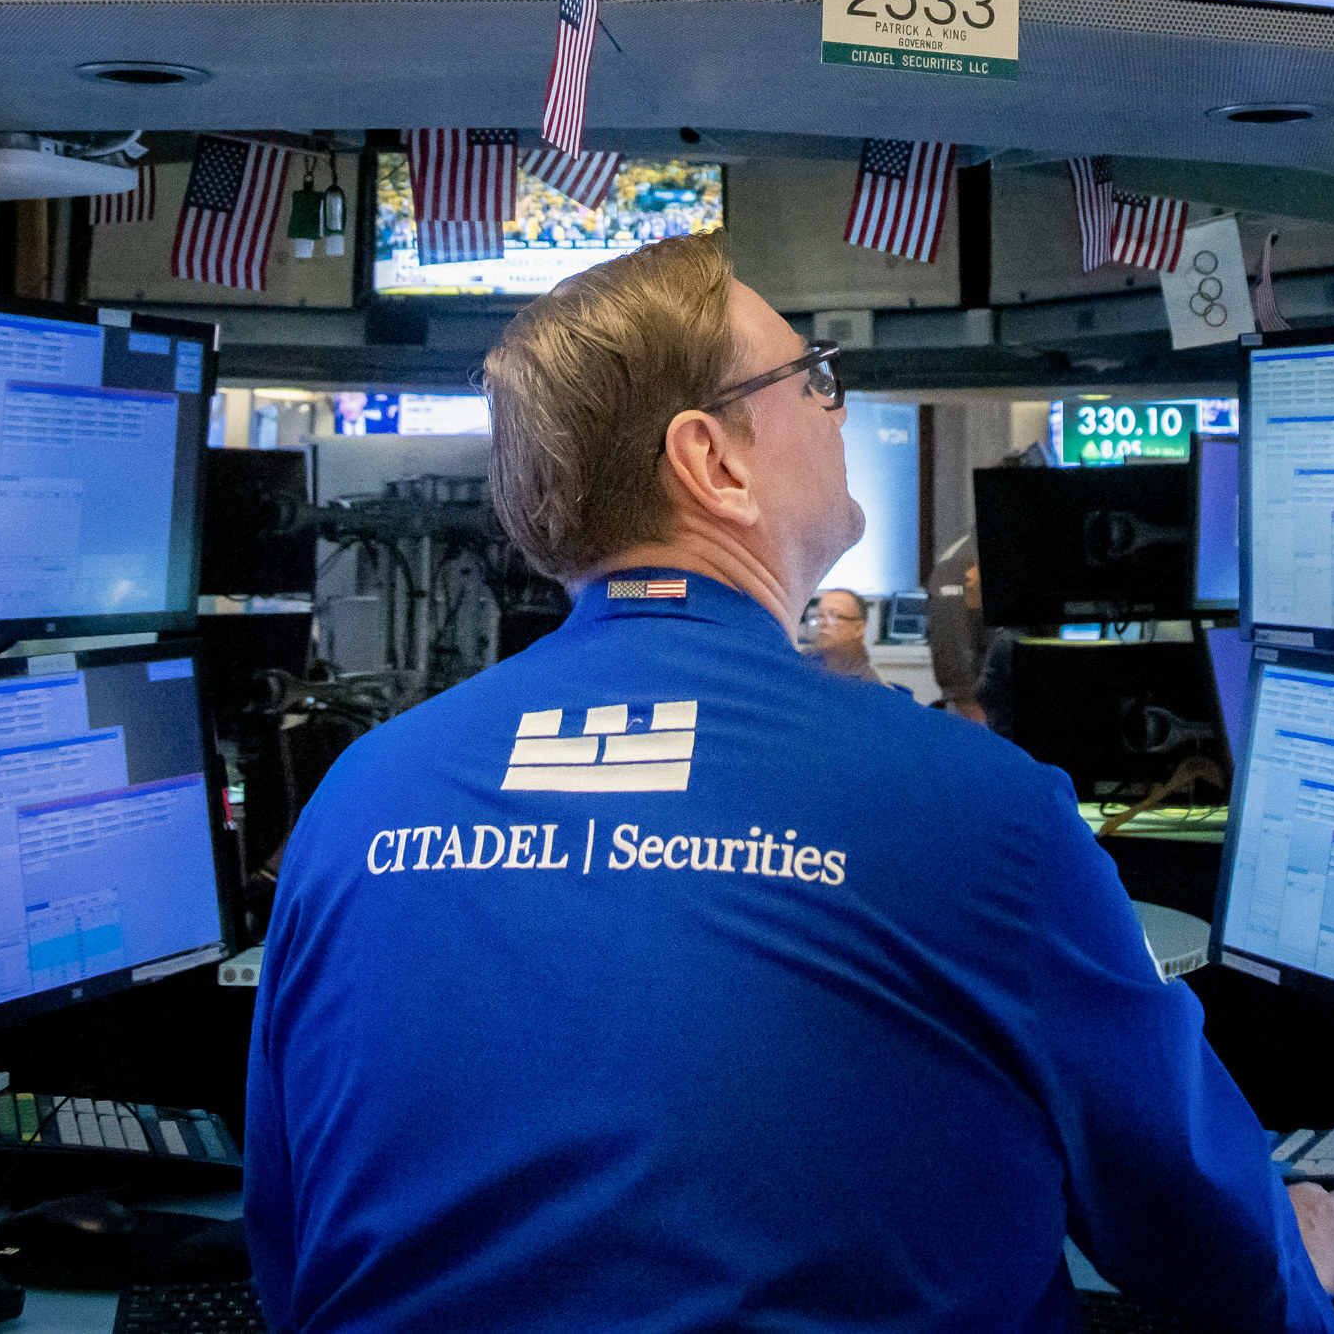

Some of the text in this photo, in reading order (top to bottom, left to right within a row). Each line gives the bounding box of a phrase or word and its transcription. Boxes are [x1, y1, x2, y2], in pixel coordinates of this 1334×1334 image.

[875, 22, 919, 36] PATRICK
[943, 29, 967, 41] KING
[899, 38, 943, 50] GOVERNOR
[851, 50, 989, 74] CITADEL SECURITIES LLC
[1077, 406, 1182, 437] 330.10
[367, 822, 847, 886] CITADEL Securities
